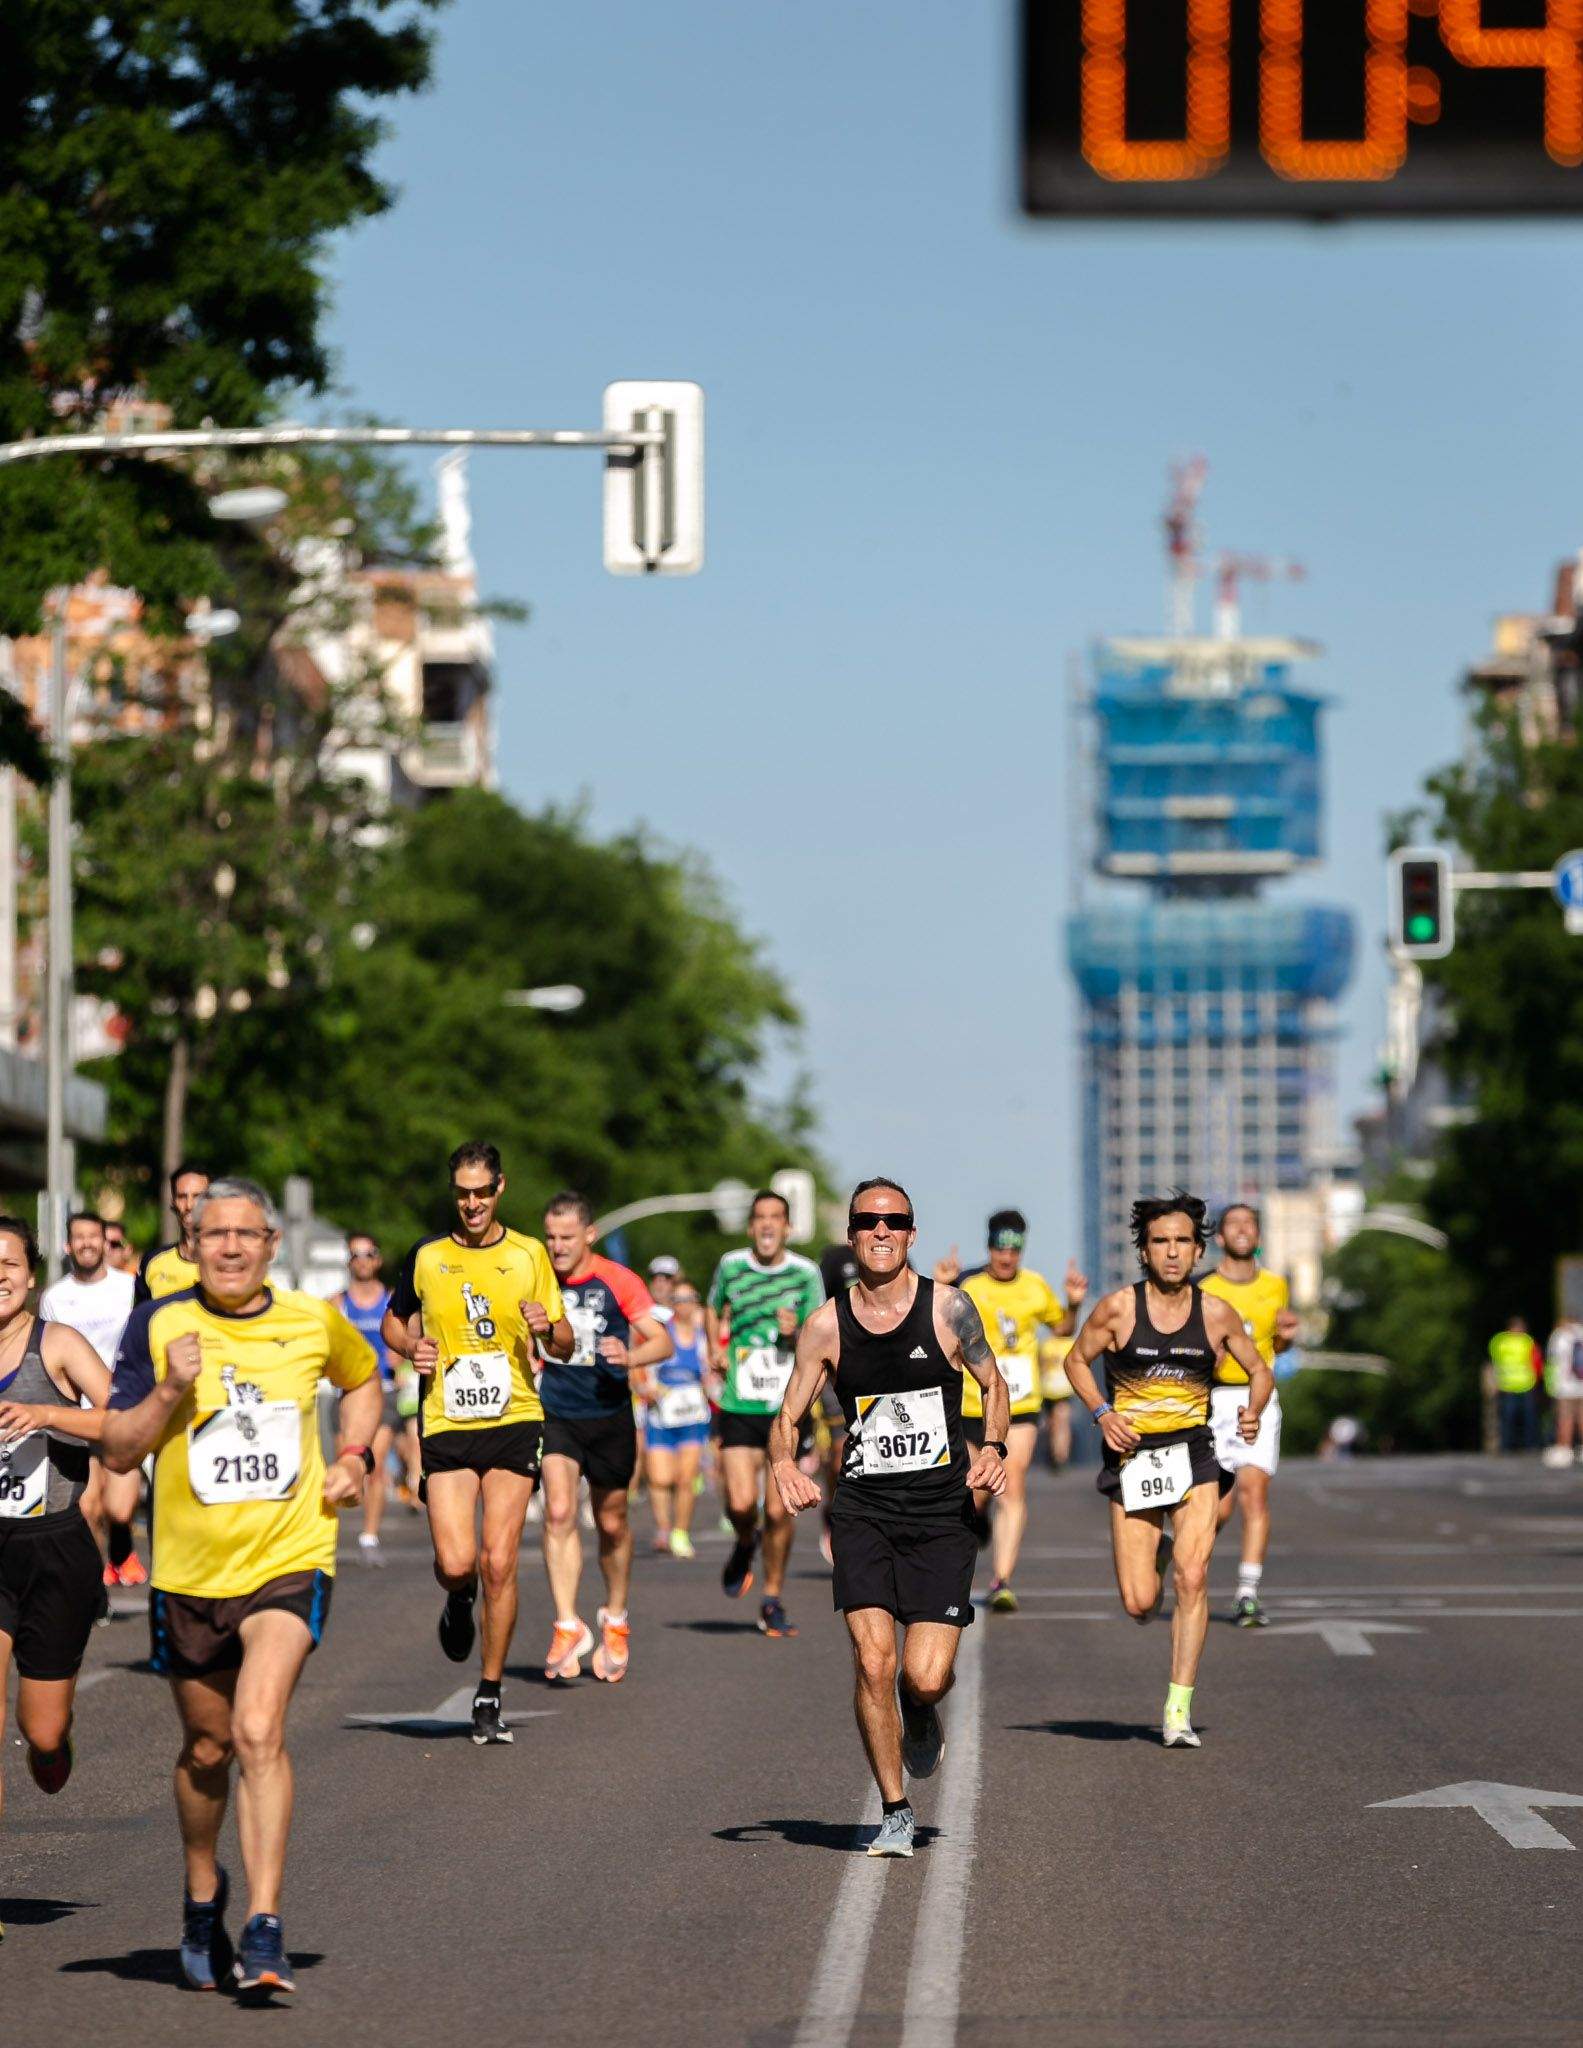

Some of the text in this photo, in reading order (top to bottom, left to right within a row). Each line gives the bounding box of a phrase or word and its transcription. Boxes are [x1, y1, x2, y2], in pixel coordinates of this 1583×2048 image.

[479, 1321, 493, 1335] 13
[455, 1386, 500, 1406] 3582
[879, 1432, 930, 1459] 3672
[215, 1454, 278, 1483] 2138
[1141, 1476, 1175, 1498] 994
